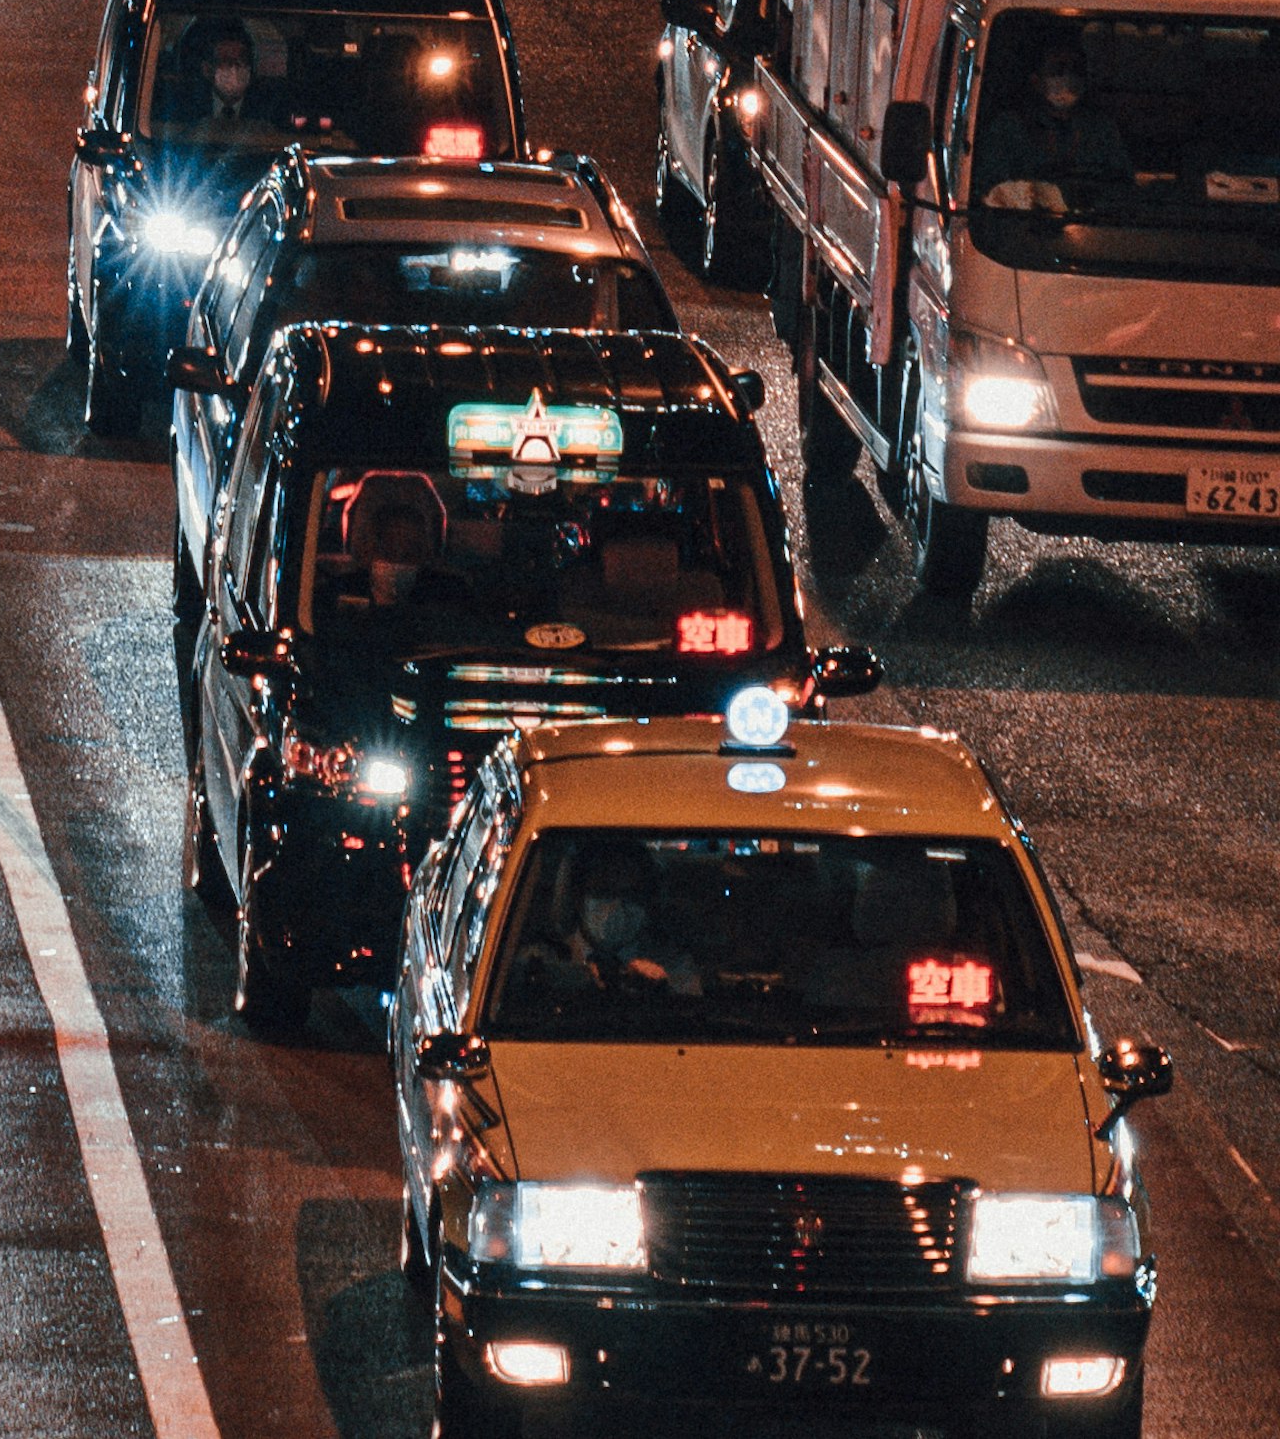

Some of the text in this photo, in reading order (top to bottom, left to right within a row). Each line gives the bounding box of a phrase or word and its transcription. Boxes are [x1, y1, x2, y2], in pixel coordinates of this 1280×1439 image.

[1206, 485, 1279, 514] 62-43
[678, 611, 753, 655] 空車
[907, 958, 992, 1008] 空車
[769, 1346, 872, 1385] 37-52
